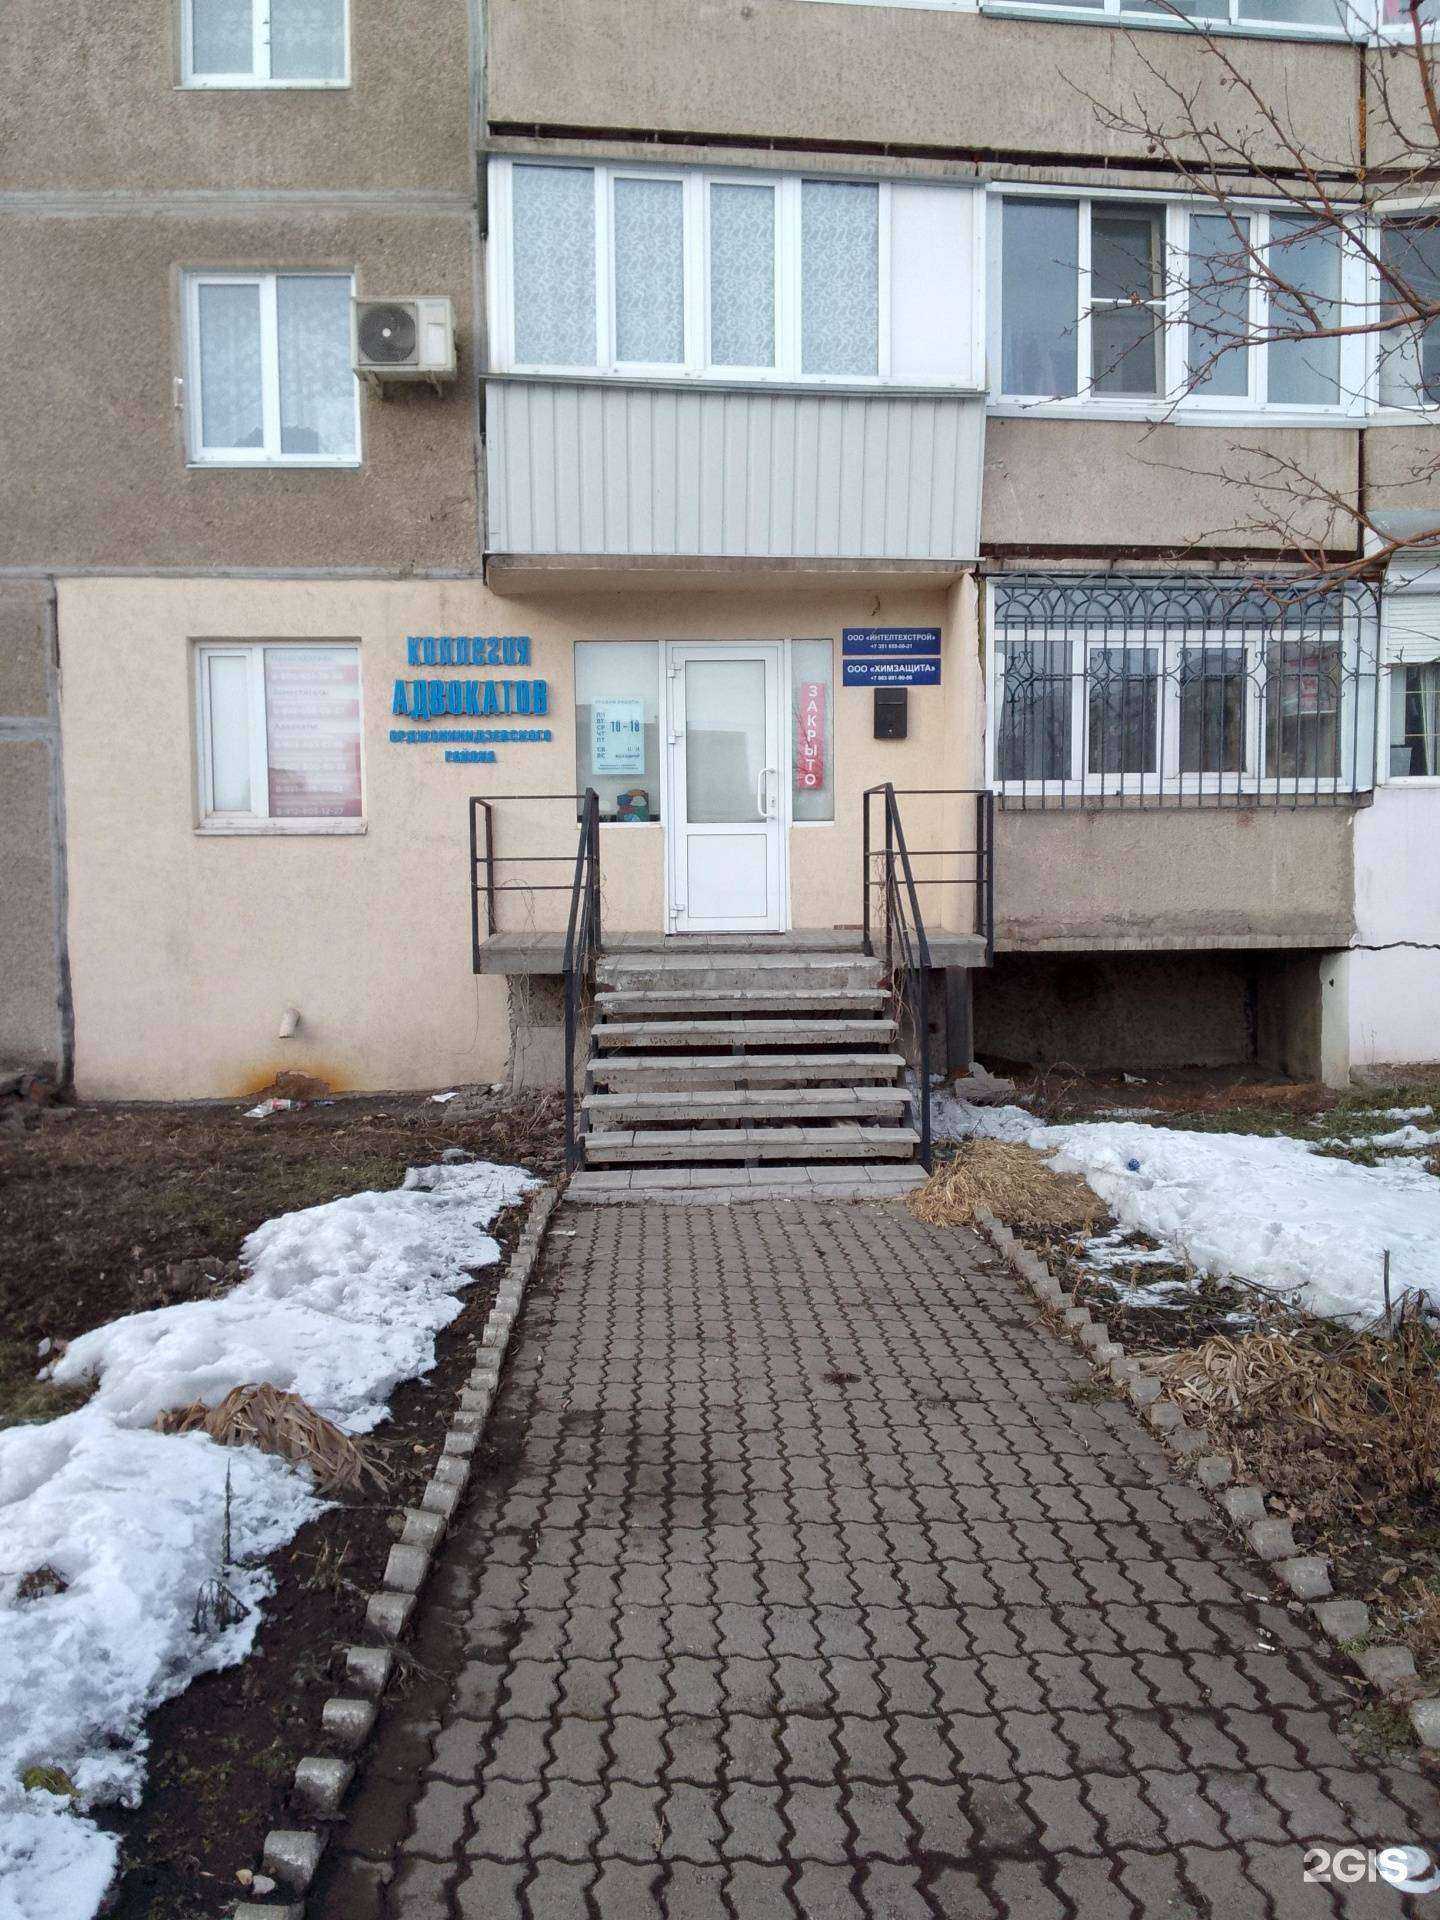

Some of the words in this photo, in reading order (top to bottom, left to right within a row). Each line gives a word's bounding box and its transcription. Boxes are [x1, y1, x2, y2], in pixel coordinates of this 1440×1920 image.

[847, 664, 868, 673] ООО
[870, 664, 936, 673] «ХИМЗАЩИТА»
[391, 680, 549, 721] АДВОКАТОВ
[804, 685, 818, 785] ЗАКРЫТО
